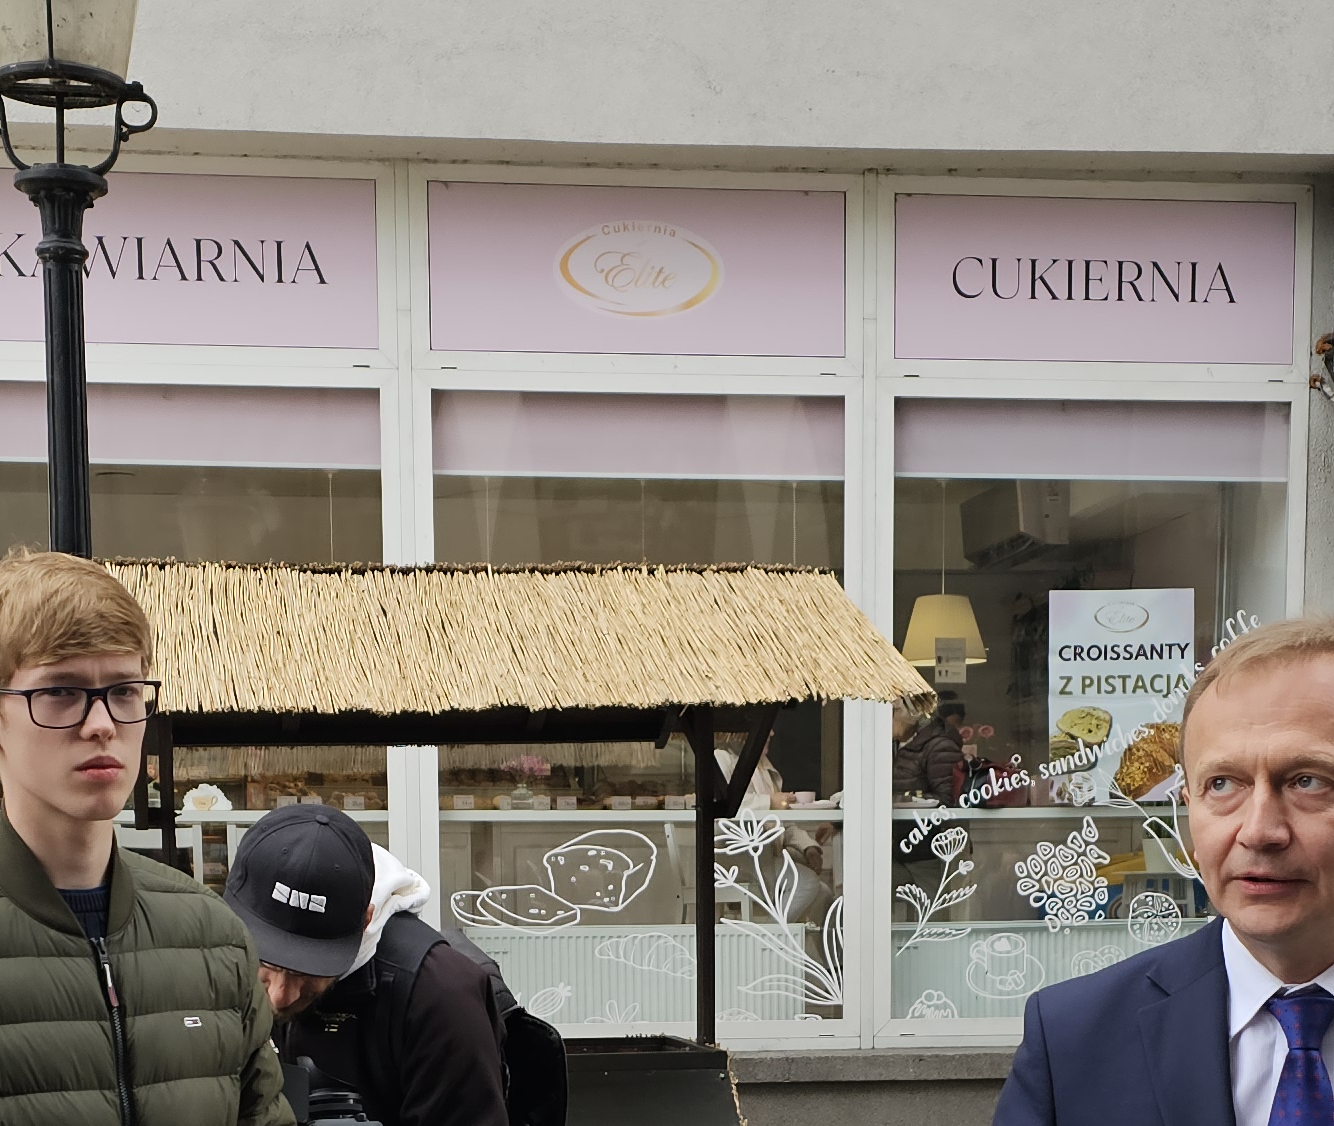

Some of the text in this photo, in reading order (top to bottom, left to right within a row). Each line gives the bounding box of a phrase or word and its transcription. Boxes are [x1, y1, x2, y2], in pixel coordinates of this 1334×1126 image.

[601, 221, 677, 238] Cukiernia
[952, 256, 1237, 304] CUKIERNIA
[1058, 642, 1191, 662] CROISSANTY
[1058, 675, 1074, 696] Z
